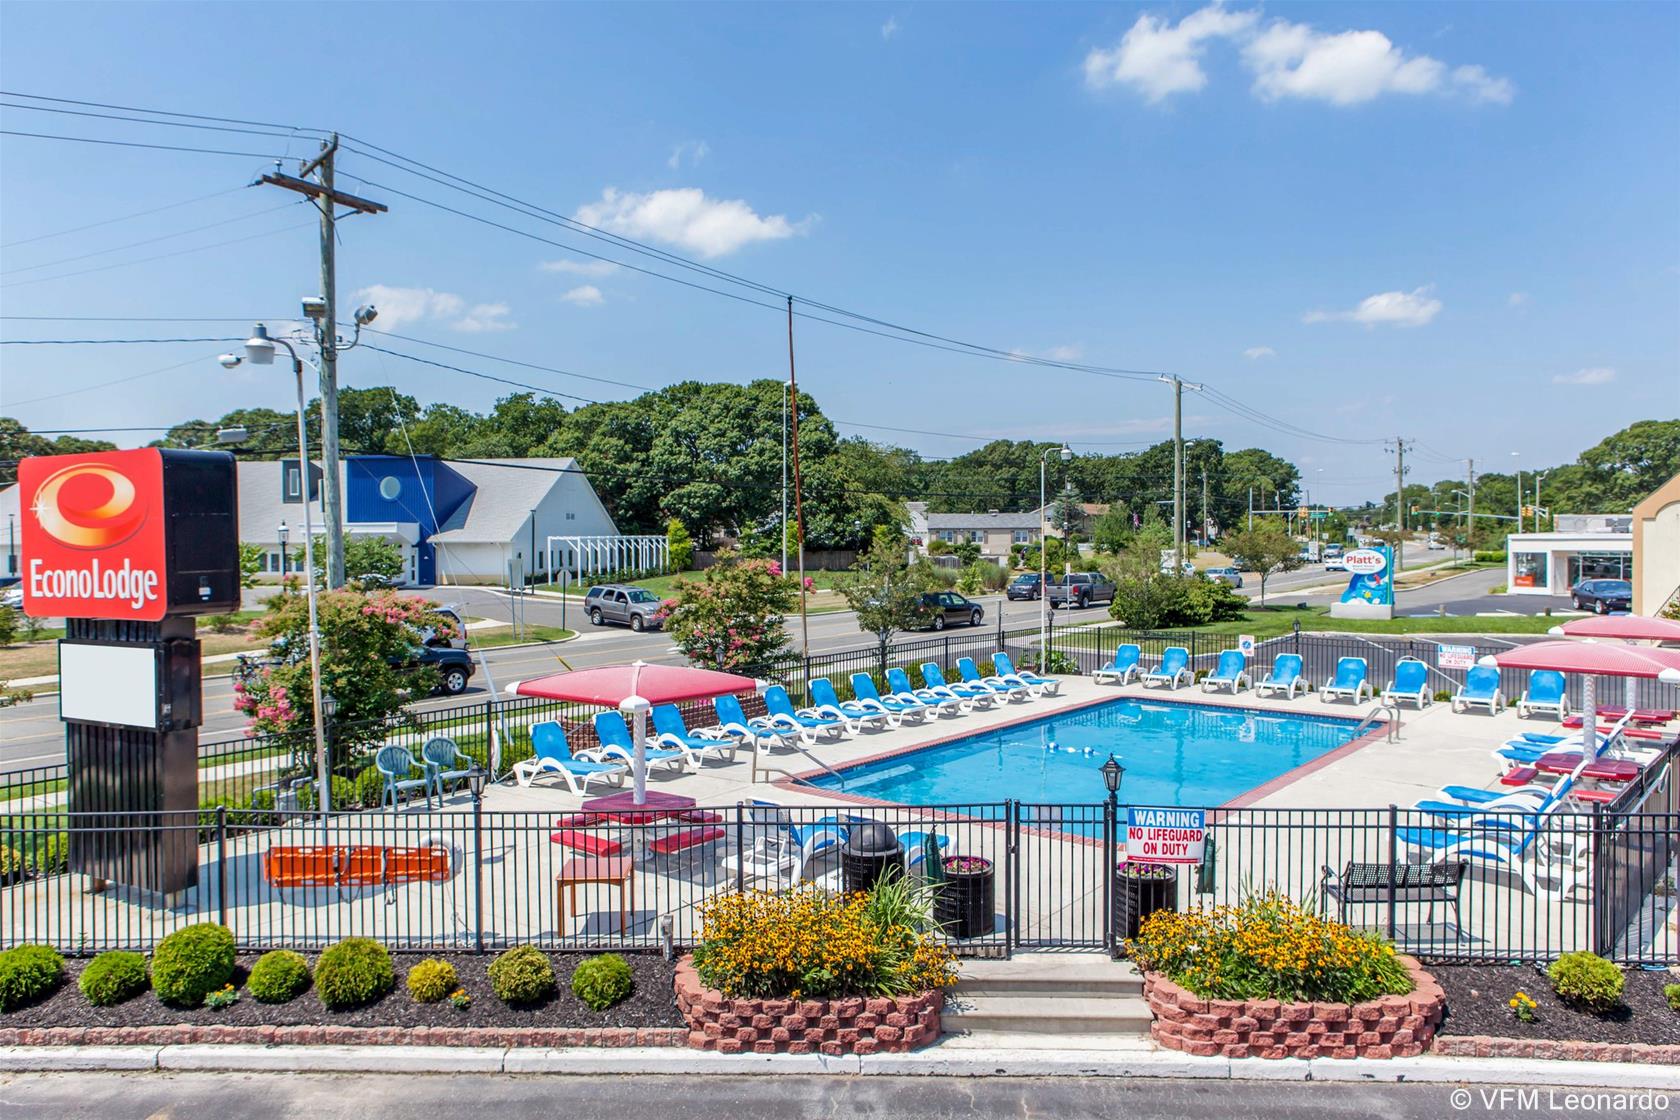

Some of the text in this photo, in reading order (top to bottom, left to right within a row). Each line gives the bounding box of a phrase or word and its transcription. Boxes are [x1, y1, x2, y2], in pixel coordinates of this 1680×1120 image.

[1346, 555, 1382, 565] Platt's
[29, 557, 158, 610] EconoLodge
[1134, 810, 1200, 828] WARNING
[1129, 827, 1203, 842] NO LIFEGUARD
[1143, 842, 1189, 856] ON DUTY
